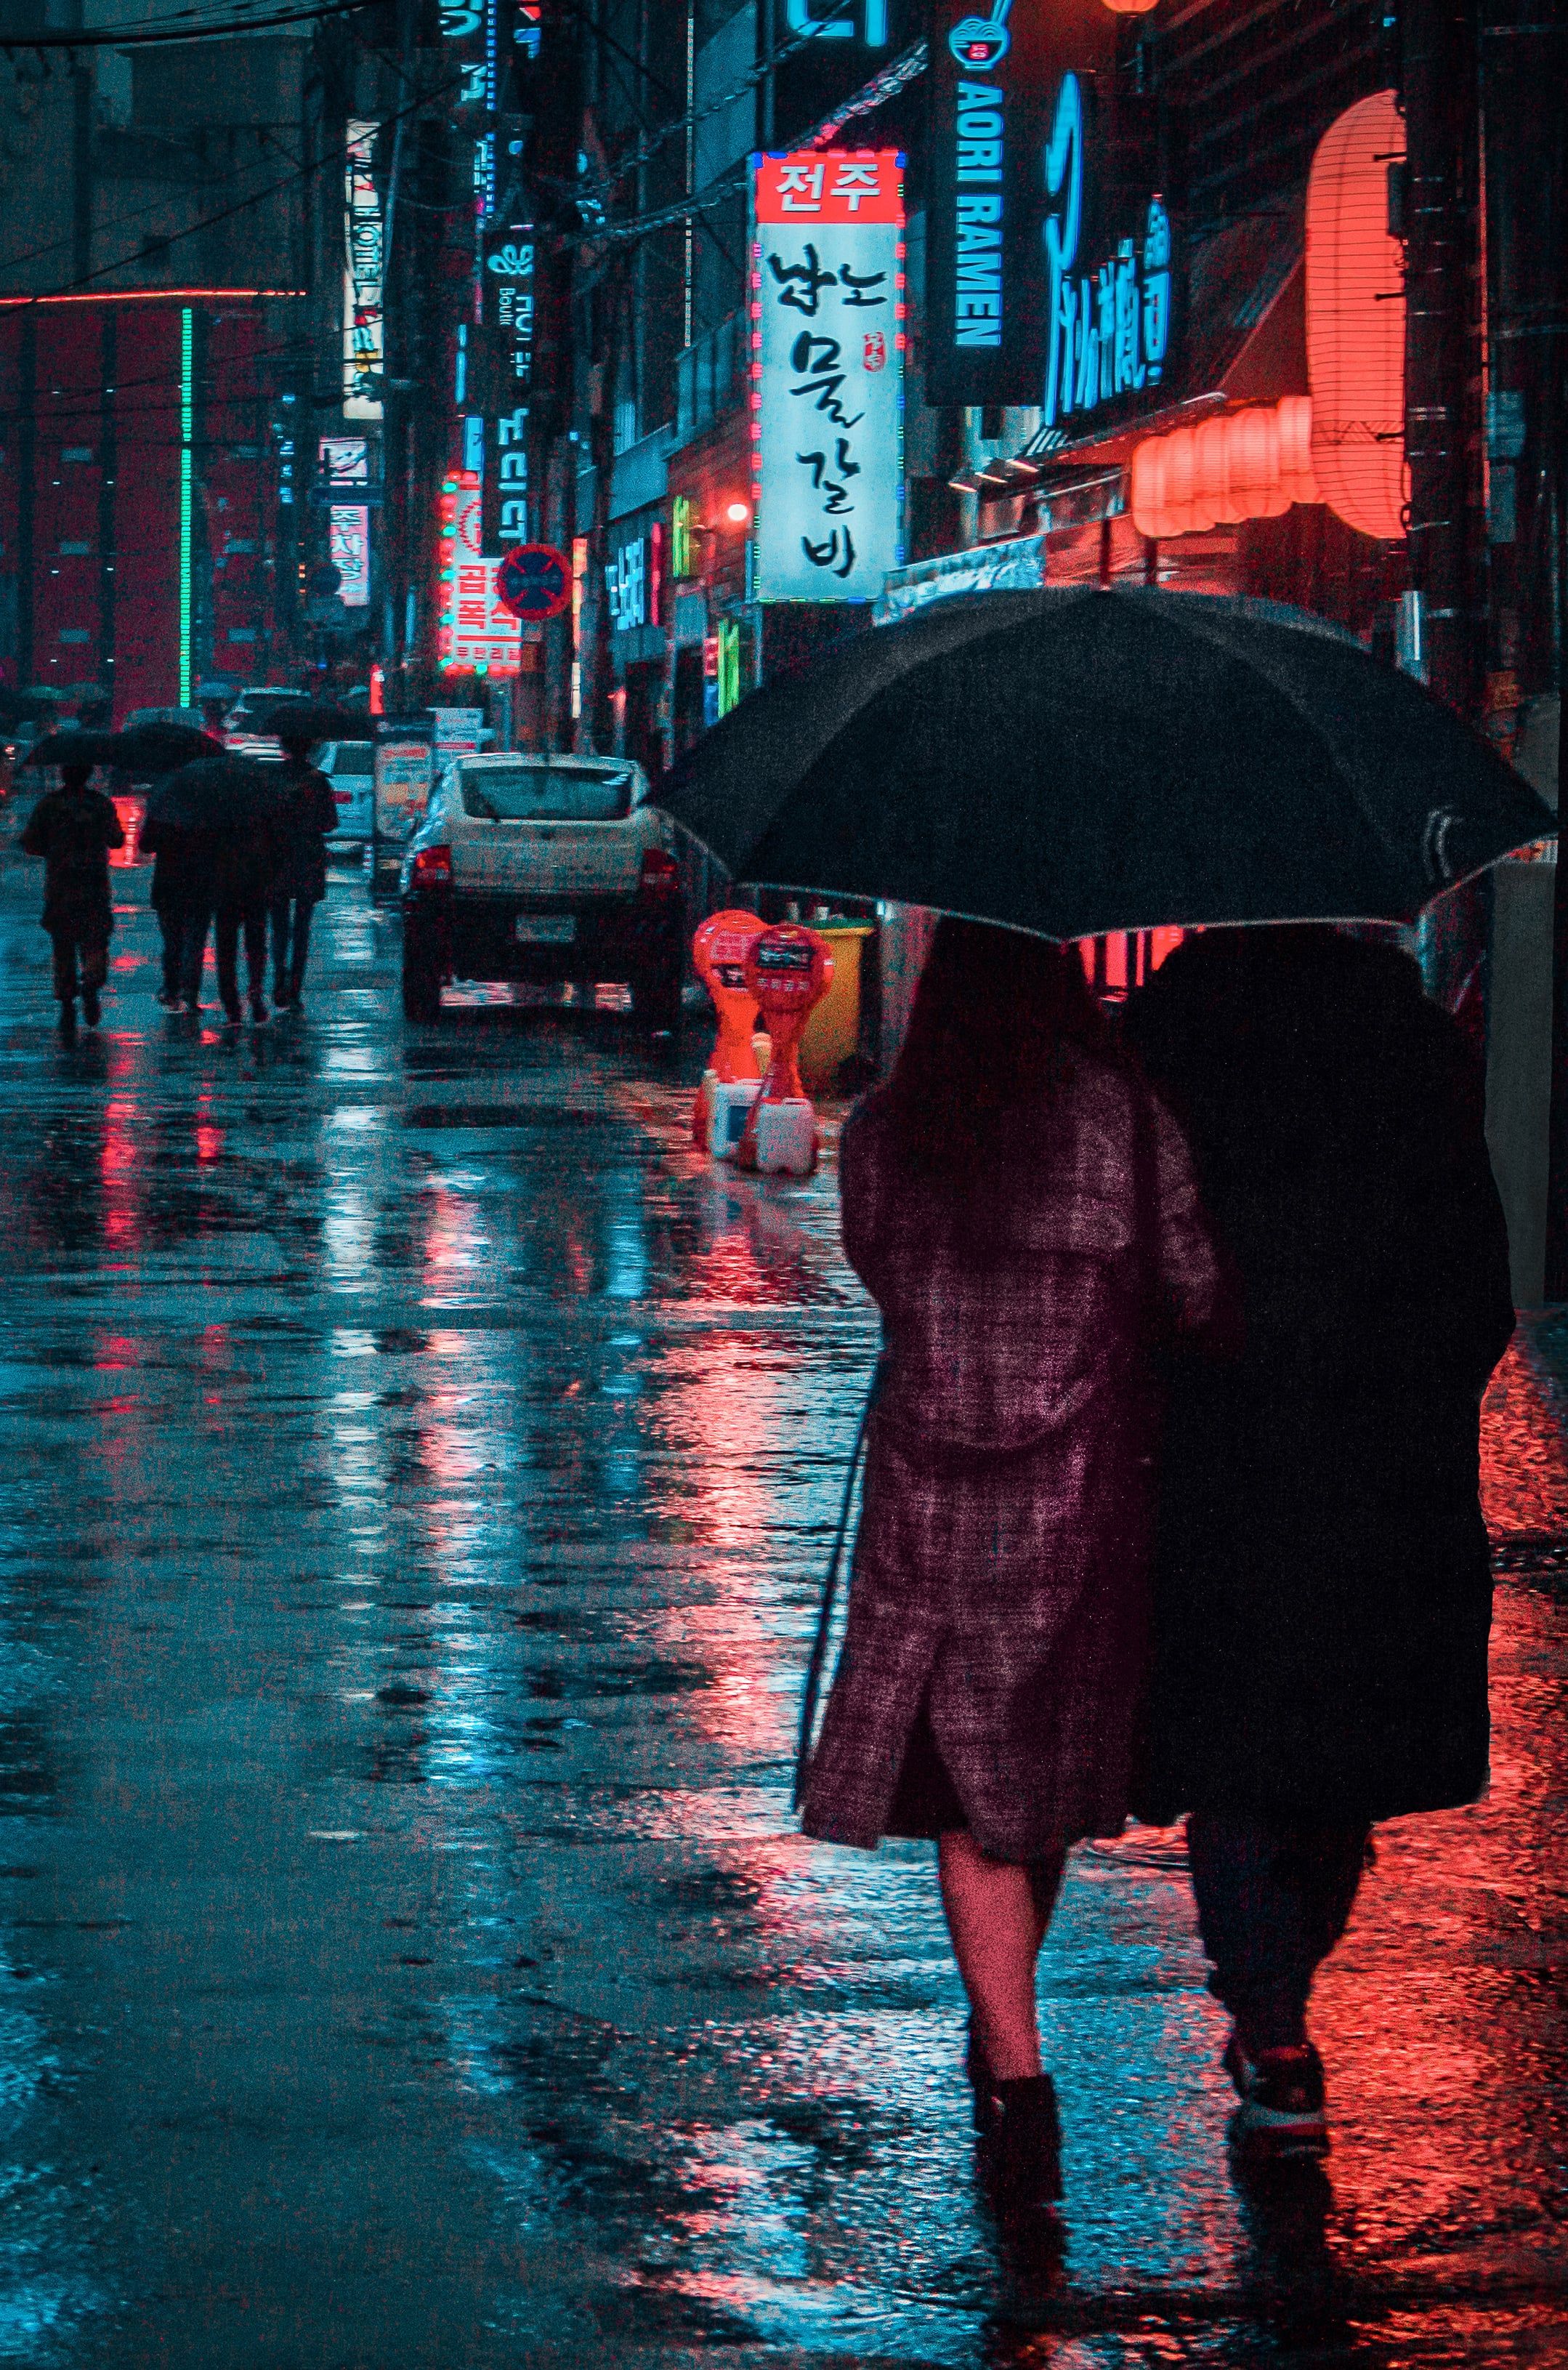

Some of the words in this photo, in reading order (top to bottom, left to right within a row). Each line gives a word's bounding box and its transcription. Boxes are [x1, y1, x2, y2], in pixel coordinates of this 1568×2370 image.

[775, 164, 881, 211] 전주
[957, 81, 1003, 182] AORI
[956, 193, 1003, 347] RAMEN
[789, 330, 865, 579] 물갈비
